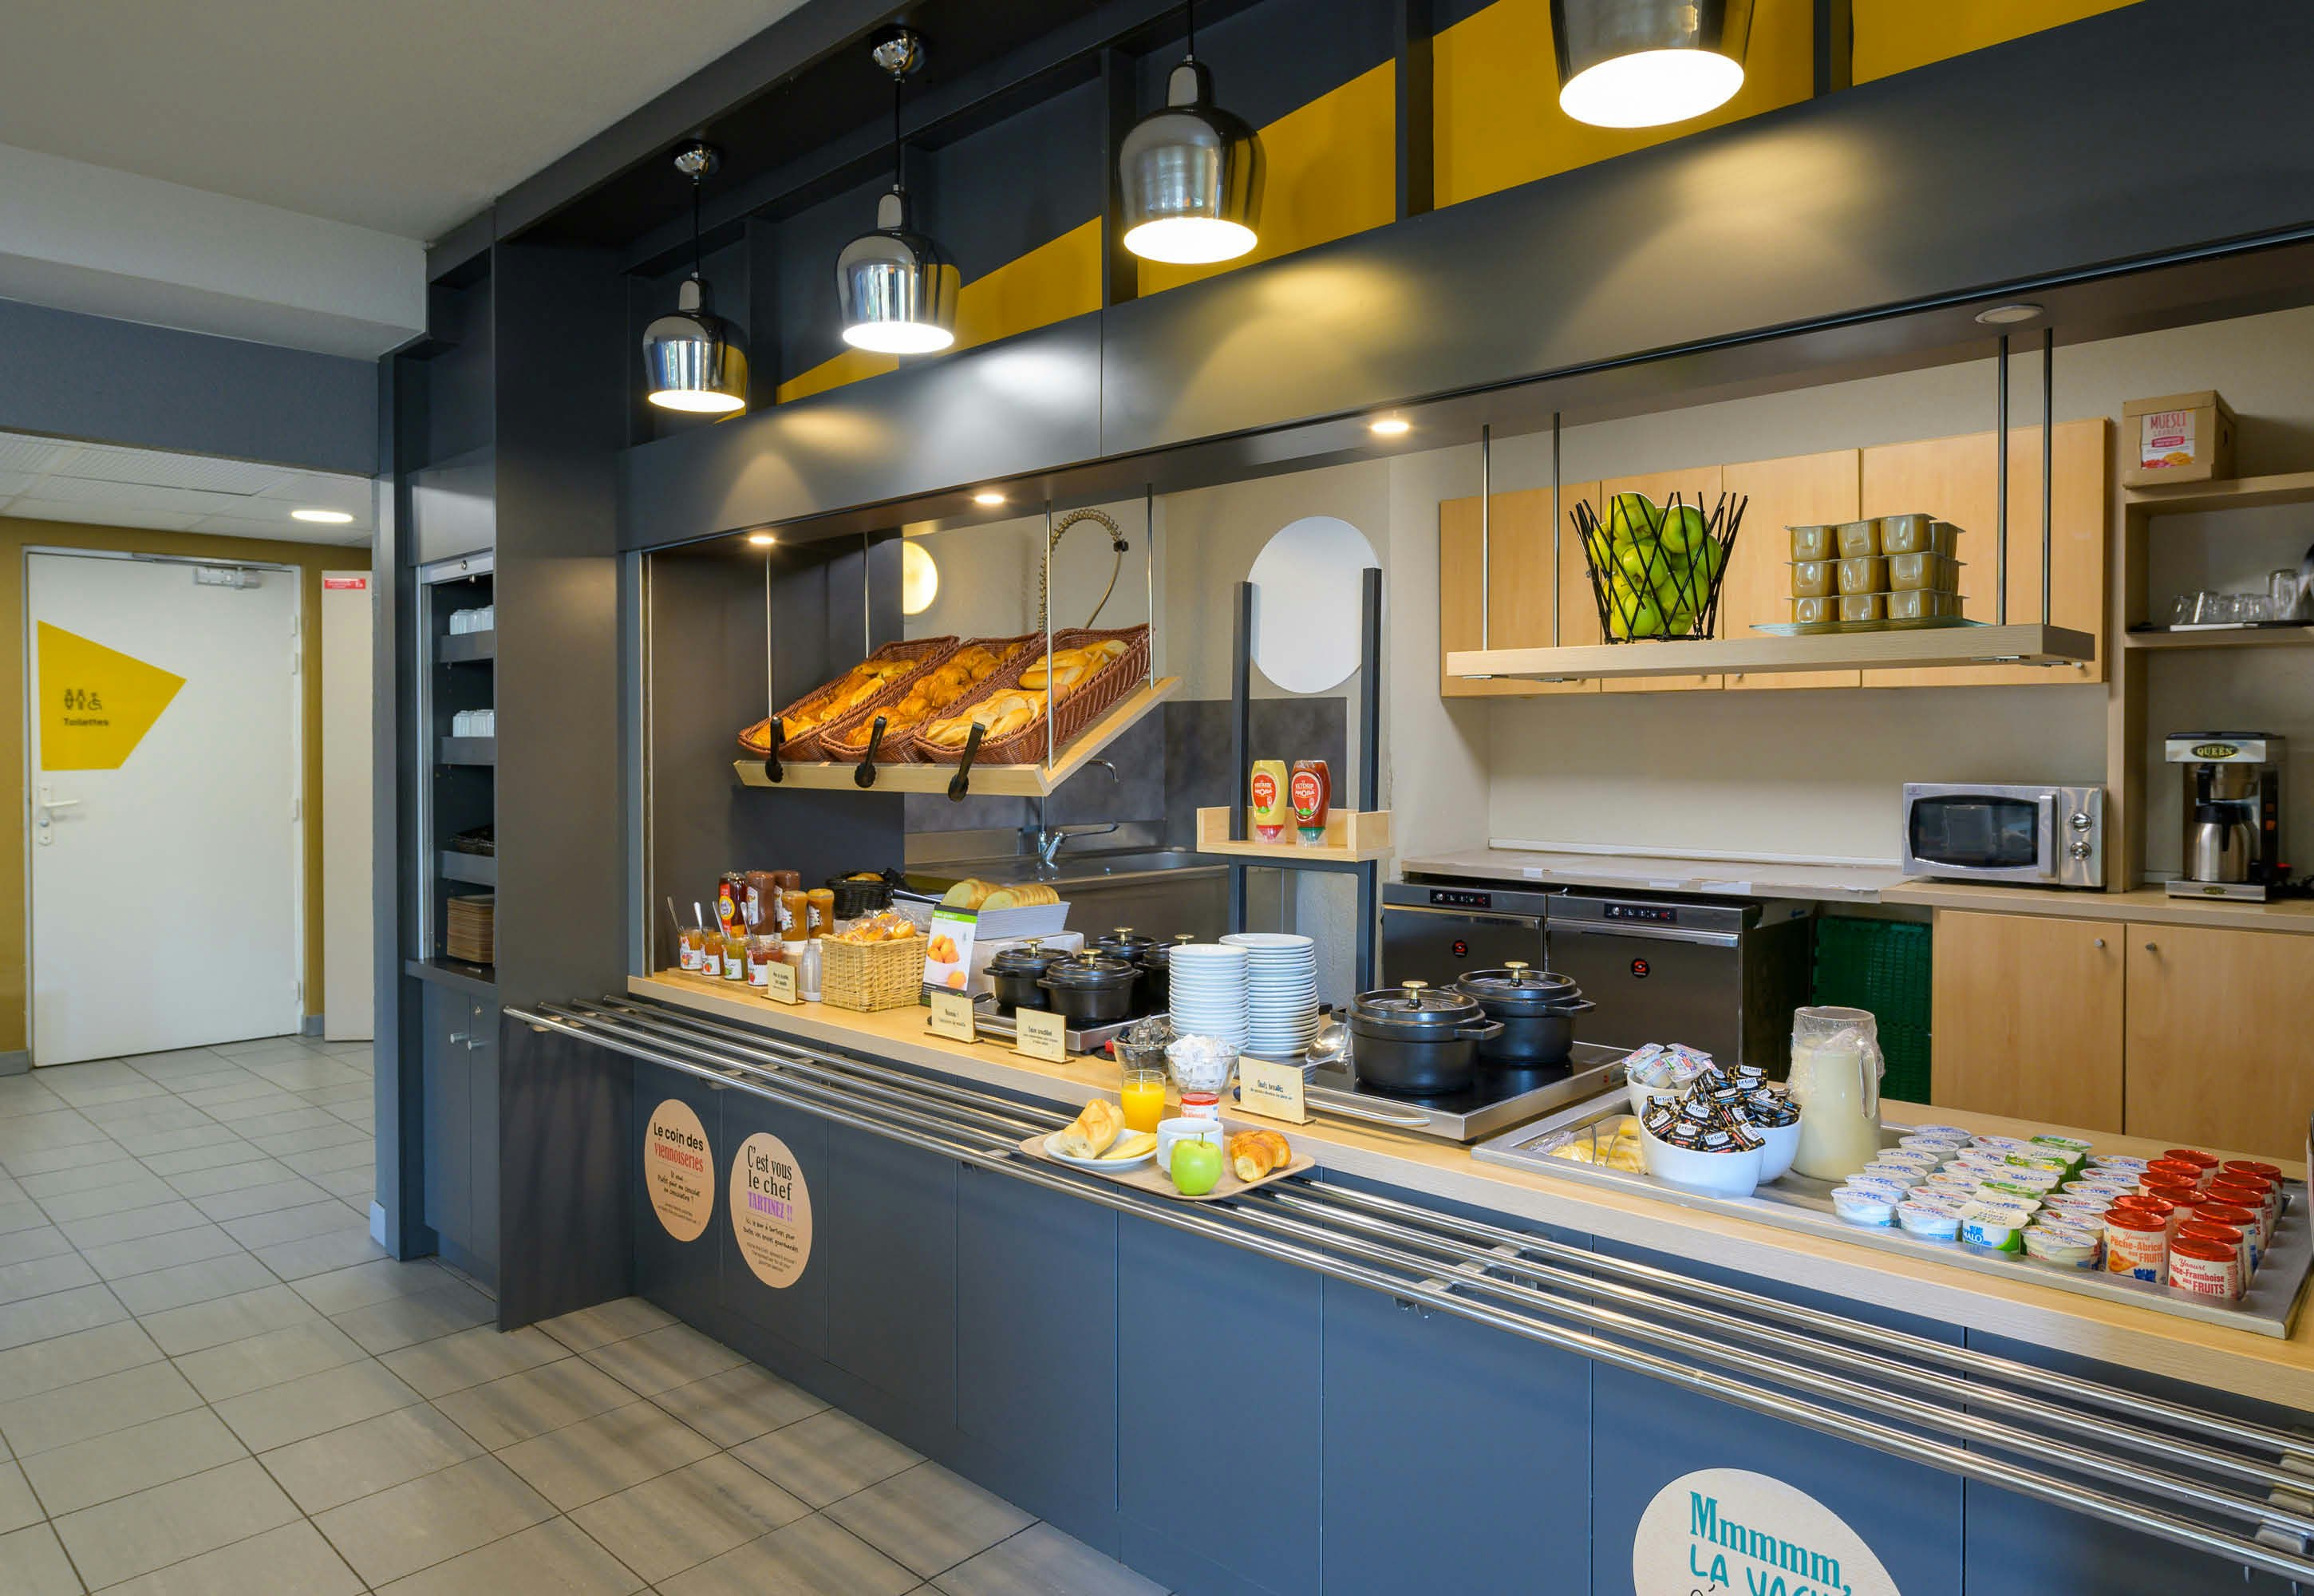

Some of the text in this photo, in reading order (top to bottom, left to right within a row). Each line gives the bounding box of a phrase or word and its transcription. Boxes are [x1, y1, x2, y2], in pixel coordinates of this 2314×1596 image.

[2151, 412, 2187, 429] MUESLI
[64, 717, 109, 727] Toilettes
[2197, 746, 2233, 757] QUEEN
[654, 1122, 704, 1152] Le coin des
[654, 1138, 704, 1173] viennoiseries
[747, 1145, 792, 1181] C'est vous
[748, 1169, 792, 1201] le chef
[747, 1191, 784, 1219] TARTINEZ
[2139, 1252, 2164, 1264] FRUITS
[2178, 1258, 2207, 1271] Yaourt
[2170, 1263, 2225, 1283] raise-Framboise
[2193, 1280, 2225, 1296] FRUITS
[1690, 1543, 1730, 1589] LA
